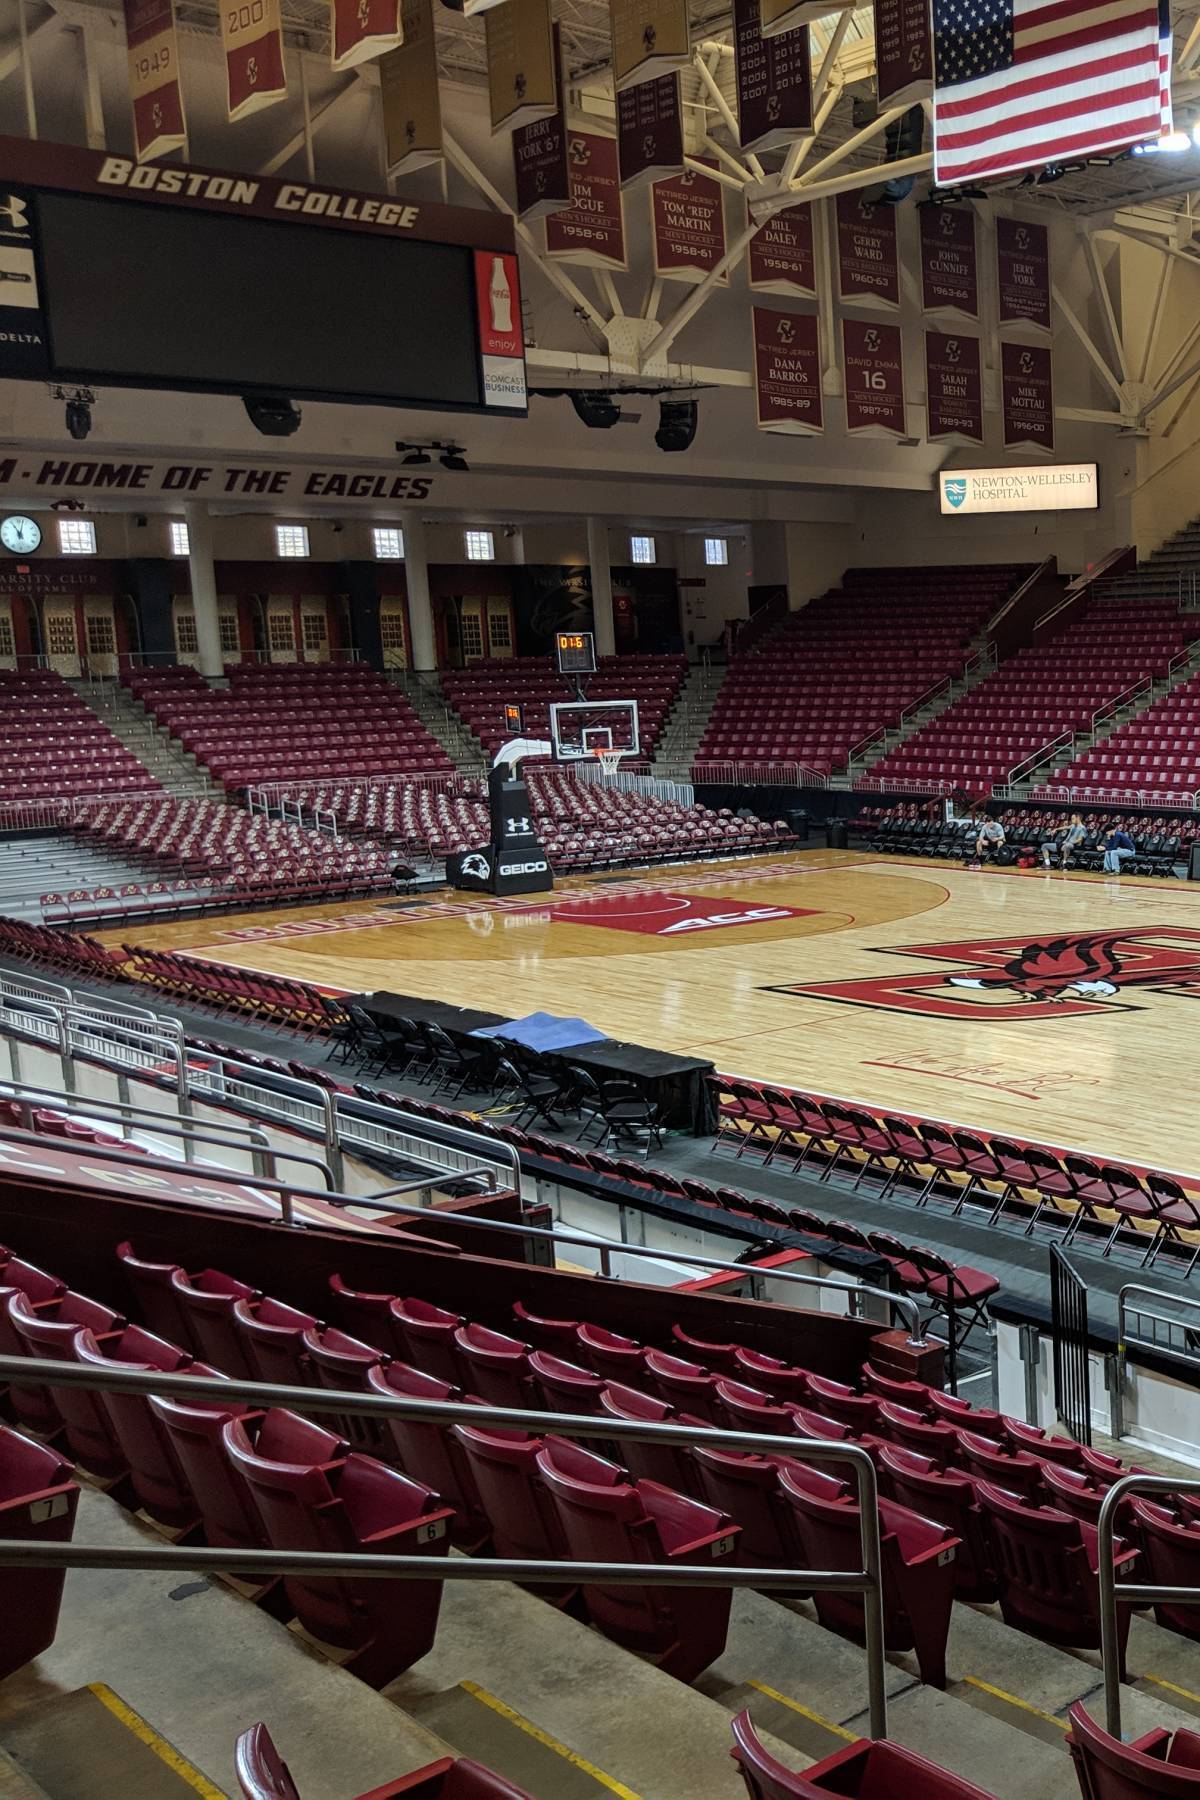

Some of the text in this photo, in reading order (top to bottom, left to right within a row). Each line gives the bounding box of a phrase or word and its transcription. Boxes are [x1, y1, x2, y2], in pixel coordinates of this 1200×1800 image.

[740, 42, 765, 56] 2001
[774, 43, 801, 60] 2012
[135, 47, 170, 82] 1949
[741, 56, 767, 71] 2004
[775, 59, 801, 75] 2014
[742, 71, 767, 86] 2006
[776, 75, 802, 90] 2016
[742, 85, 768, 101] 2007
[524, 119, 551, 141] JERRY
[518, 140, 543, 161] YORK
[97, 157, 420, 229] BOSTON COLLEGE
[573, 184, 592, 196] JIM
[570, 199, 605, 213] OGUE
[661, 200, 686, 214] TOM
[666, 215, 712, 232] MARTIN
[771, 219, 792, 232] BILL
[562, 225, 609, 241] 1958-61
[765, 231, 798, 245] DALEY
[853, 235, 882, 249] GERRY
[670, 243, 713, 258] 1958-61
[854, 246, 883, 261] WARD
[938, 250, 960, 263] JOHN
[763, 258, 803, 272] 1958-61
[929, 261, 969, 275] CUNNIFF
[1013, 263, 1034, 275] JERRY
[1013, 274, 1036, 287] YORK
[932, 286, 969, 299] 1963-66
[0, 332, 42, 345] DELTA
[488, 338, 516, 352] enjoy
[774, 357, 802, 371] DANA
[847, 356, 900, 370] DAVID EMMA
[484, 374, 525, 386] COMCAST
[769, 368, 808, 383] BARROS
[861, 370, 887, 390] 16
[940, 373, 968, 386] SARAH
[484, 382, 526, 395] BUSINESS
[942, 384, 967, 397] BEHN
[1018, 386, 1038, 398] MIKE
[1011, 397, 1046, 410] MOTTAU
[36, 460, 154, 489] HOME
[161, 466, 213, 491] OF
[224, 469, 292, 494] THE
[304, 472, 434, 500] EAGLES
[972, 472, 1093, 489] NEWTON-WELLESLEY
[973, 487, 1028, 501] HOSPITAL
[0, 573, 98, 585] ARSITY CLUB
[499, 861, 548, 876] GEICO
[656, 906, 794, 934] ACC
[43, 1499, 53, 1518] 7
[427, 1524, 436, 1539] 6
[719, 1539, 727, 1553] 5
